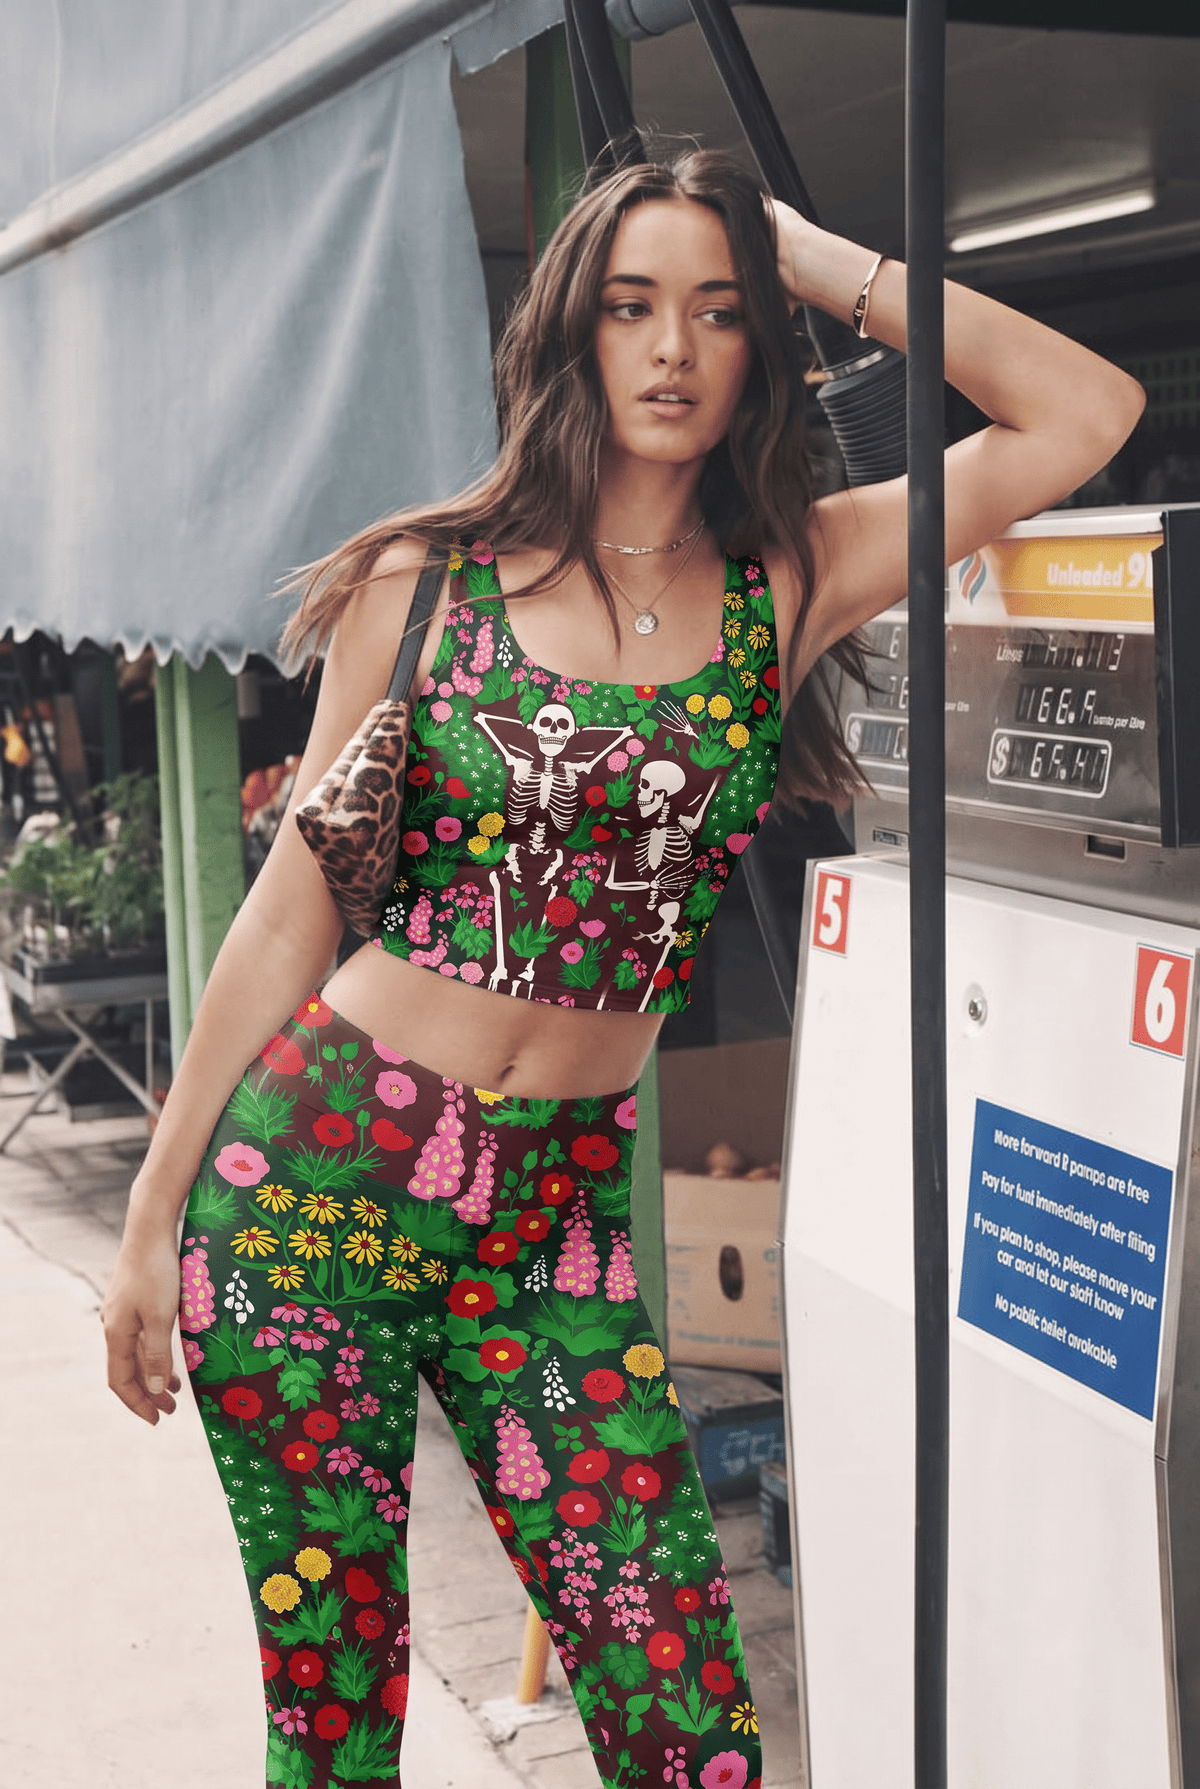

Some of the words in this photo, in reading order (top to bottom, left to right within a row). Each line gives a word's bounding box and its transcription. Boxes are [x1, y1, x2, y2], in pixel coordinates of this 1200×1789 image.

[819, 877, 843, 946] 5
[1144, 958, 1176, 1043] 6
[1020, 1136, 1061, 1168] forward
[1106, 1175, 1126, 1195] are
[1126, 1178, 1150, 1204] free
[981, 1170, 1000, 1194] Pay
[1000, 1175, 1016, 1197] for
[1035, 1189, 1100, 1237] immediately
[1099, 1221, 1127, 1245] after
[981, 1217, 1000, 1238] you
[999, 1226, 1023, 1249] plan
[1023, 1234, 1034, 1253] to
[1034, 1241, 1062, 1269] shop,
[1062, 1254, 1098, 1283] please
[1130, 1286, 1158, 1311] your
[996, 1249, 1015, 1268] car
[1049, 1274, 1070, 1293] our
[1093, 1291, 1125, 1321] know
[994, 1292, 1009, 1313] No
